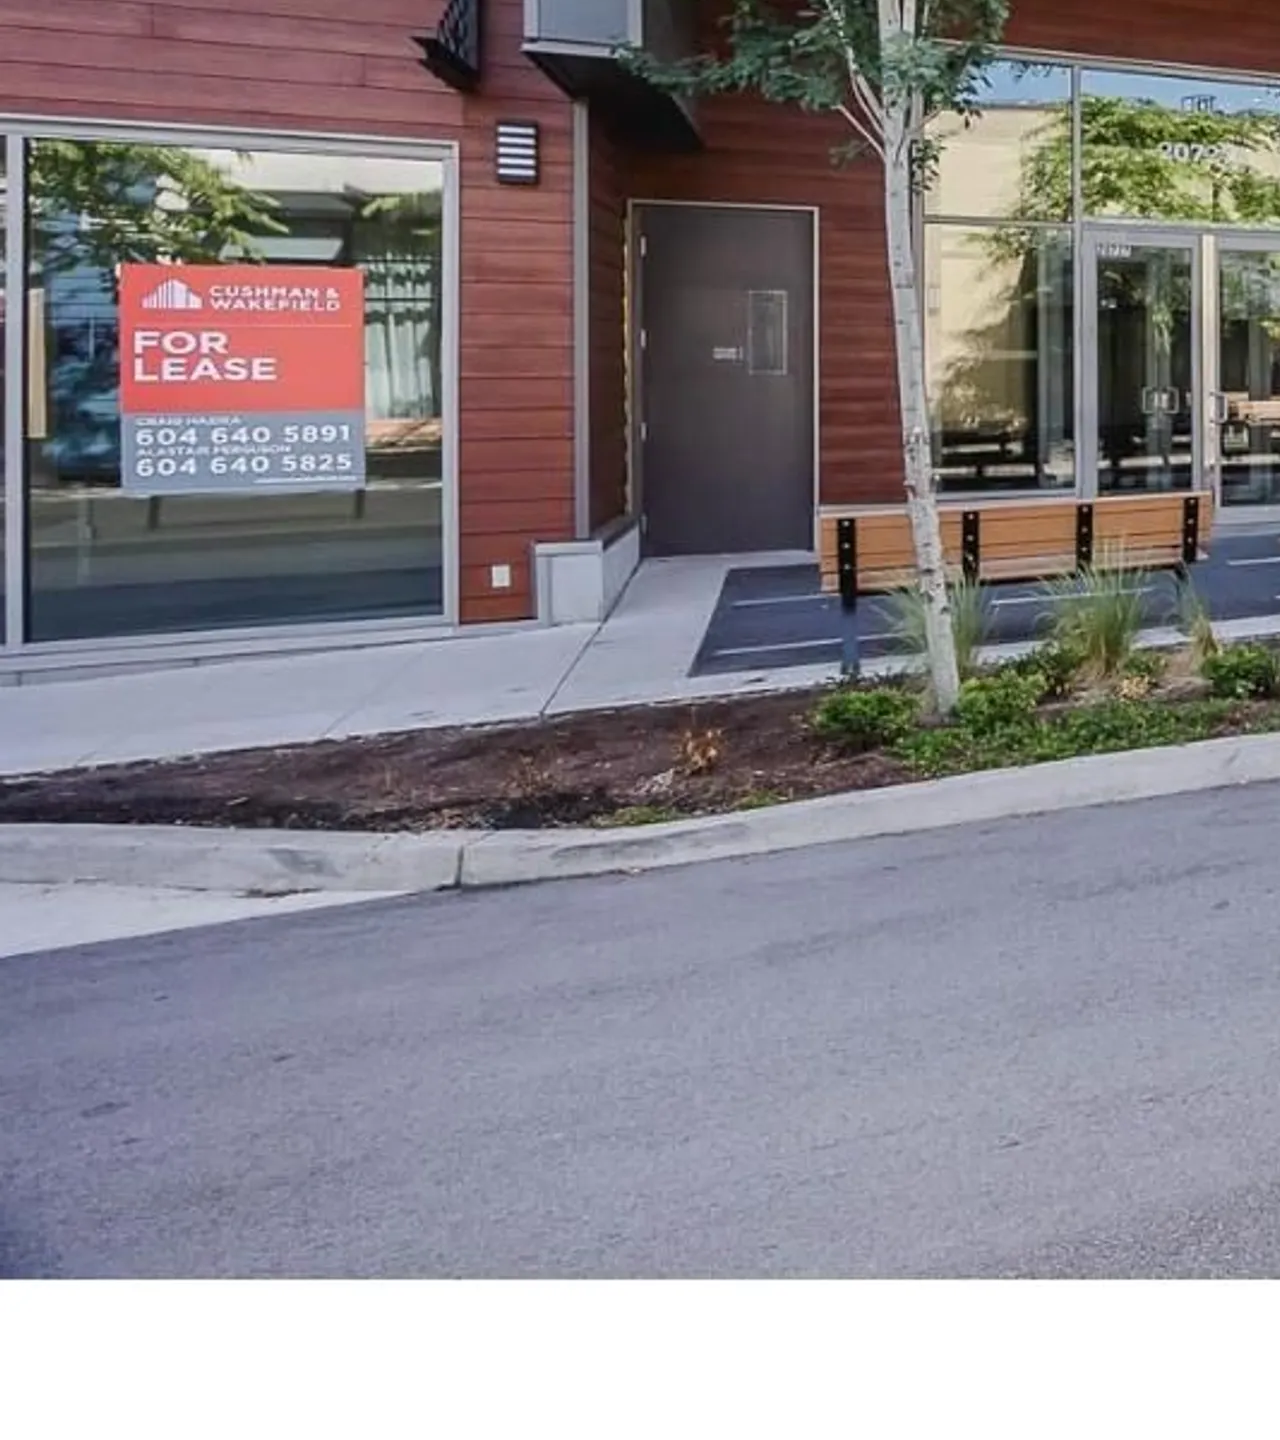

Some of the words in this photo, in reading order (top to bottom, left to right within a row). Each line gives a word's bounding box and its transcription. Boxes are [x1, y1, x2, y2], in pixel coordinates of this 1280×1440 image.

[208, 285, 320, 298] CUSHMAN
[326, 286, 340, 298] &
[210, 298, 341, 311] WAKEFIELD
[134, 331, 229, 355] FOR
[134, 358, 278, 381] LEASE
[136, 427, 198, 446] 604
[211, 426, 271, 444] 640
[284, 424, 351, 443] 5891
[136, 458, 198, 477] 604
[211, 456, 270, 475] 640
[282, 454, 352, 472] 5825
